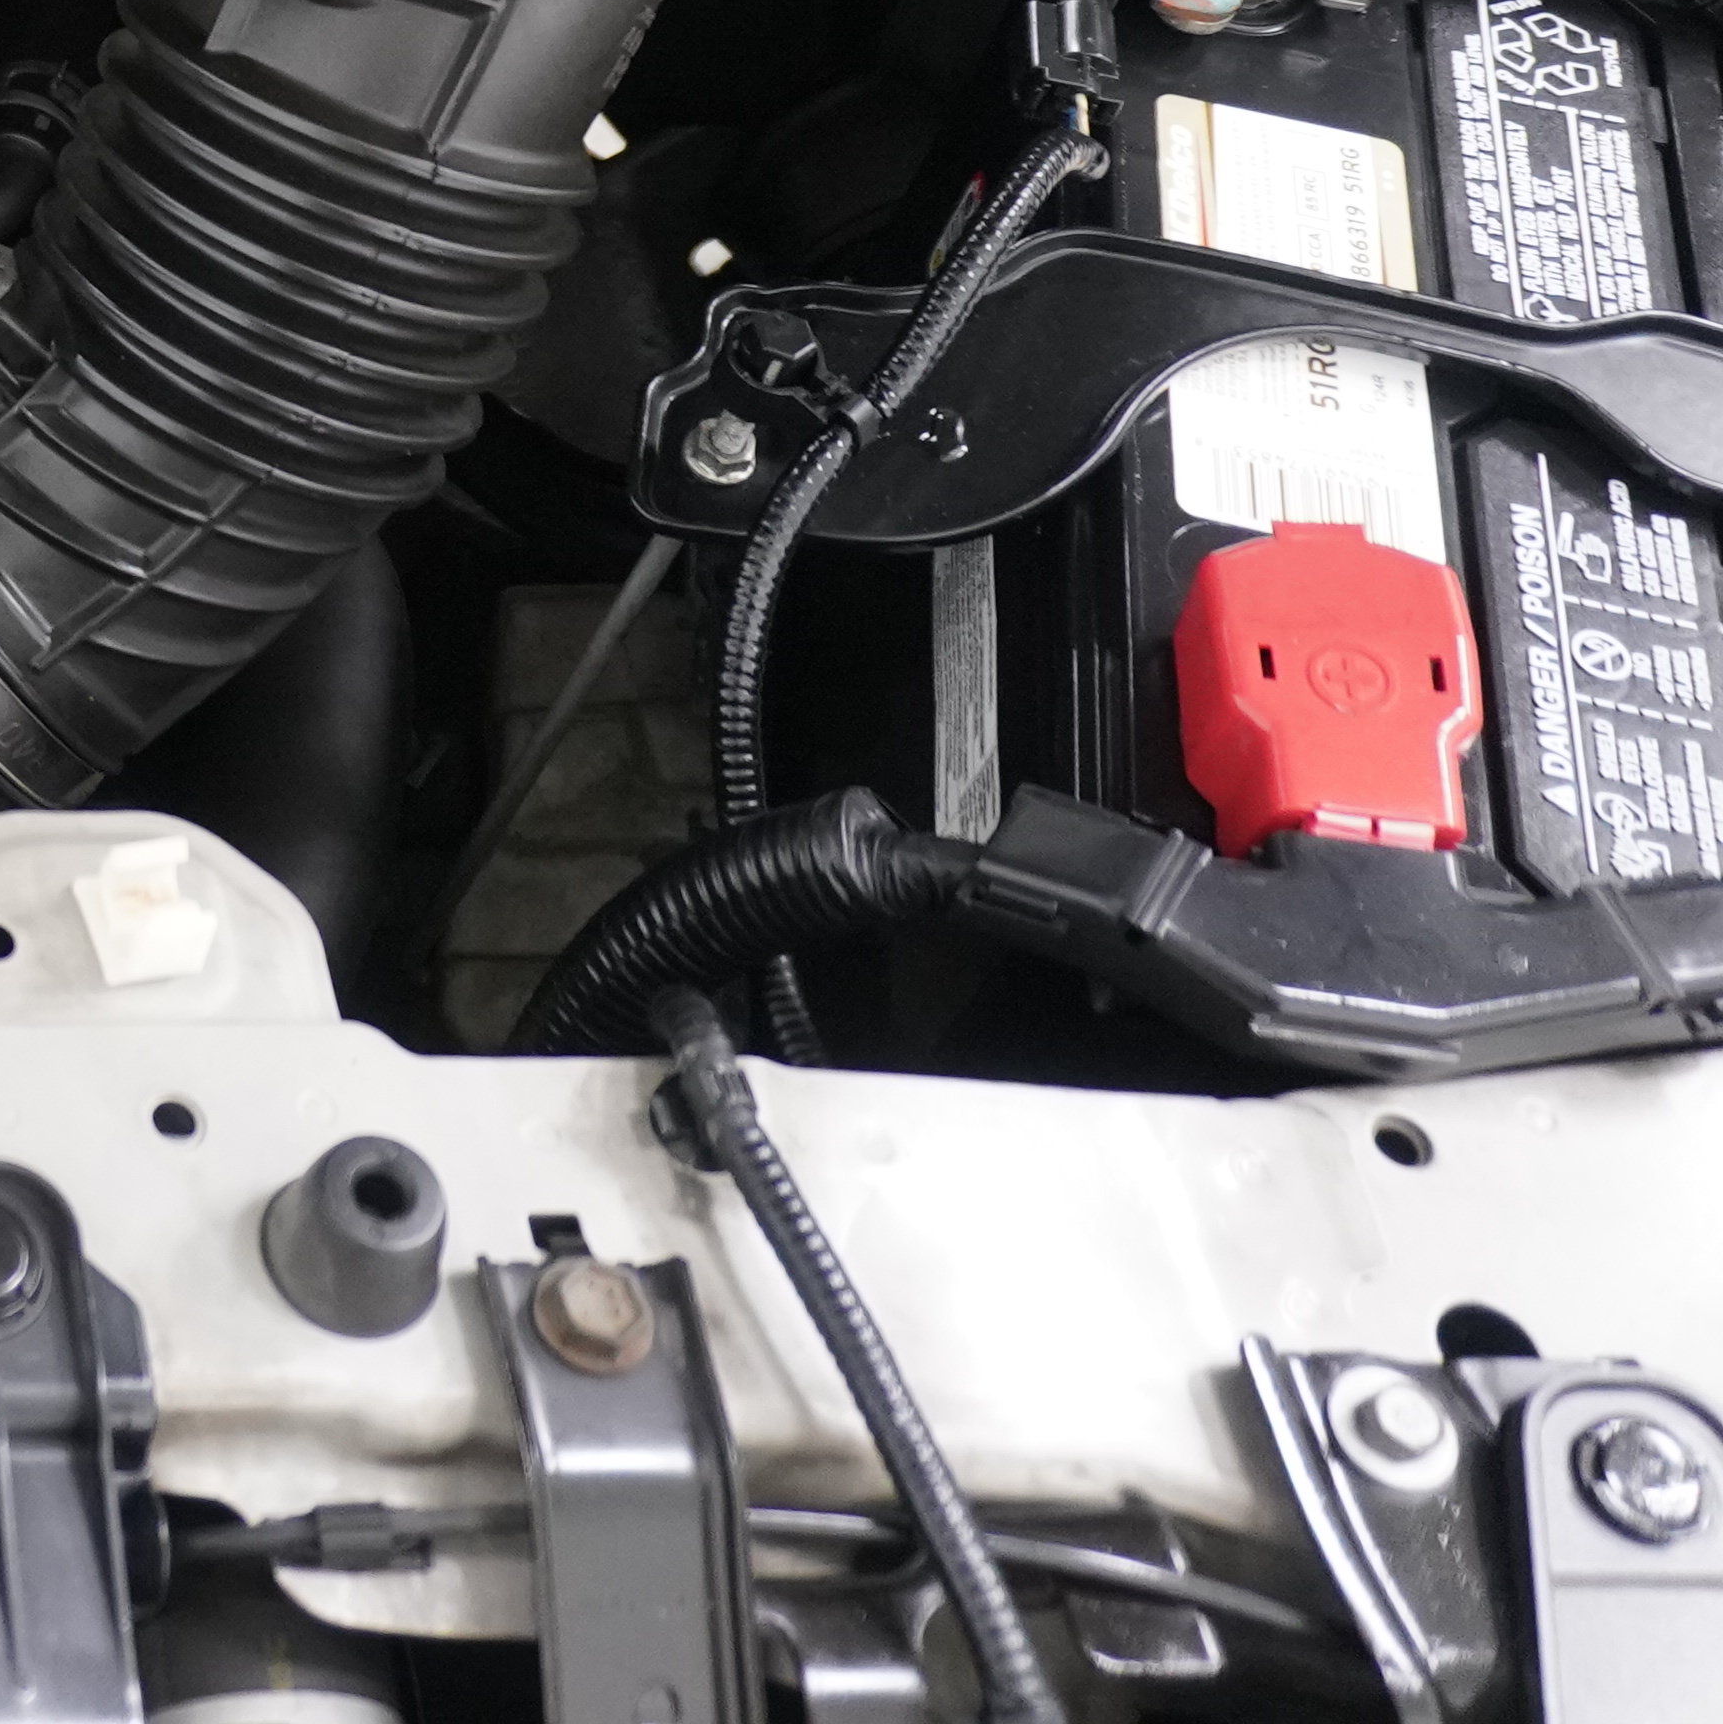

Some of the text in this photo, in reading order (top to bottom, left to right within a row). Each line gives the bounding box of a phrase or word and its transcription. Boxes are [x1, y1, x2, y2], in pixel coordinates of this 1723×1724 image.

[1464, 33, 1483, 64] LEVEL
[1601, 38, 1624, 87] RECYCLE
[1468, 65, 1486, 87] AND
[1458, 103, 1474, 119] OF
[1472, 90, 1490, 120] TIGHT
[1461, 121, 1479, 156] REACH
[1476, 123, 1494, 151] CAPS
[1579, 122, 1599, 163] FOLLOW
[1464, 157, 1481, 179] THE
[1479, 153, 1498, 181] VENT
[1303, 174, 1317, 193] RC
[1466, 180, 1483, 198] OF
[1482, 183, 1501, 211] KEEP
[1533, 176, 1554, 205] GET
[1340, 146, 1372, 277] 866319 51RG
[1468, 200, 1486, 224] OUT
[1504, 119, 1544, 292] FLUSH EYES IMMEDIATELY
[1309, 232, 1323, 259] CCA
[1469, 226, 1490, 254] KEEP
[1552, 165, 1588, 301] MEDICAL HELP FAST
[1488, 239, 1507, 263] NOT
[1491, 265, 1510, 282] DO
[1541, 260, 1564, 296] WITH
[1607, 478, 1643, 593] SULFURIC ACID
[1510, 502, 1553, 618] POISON
[1528, 646, 1576, 782] DANGER
